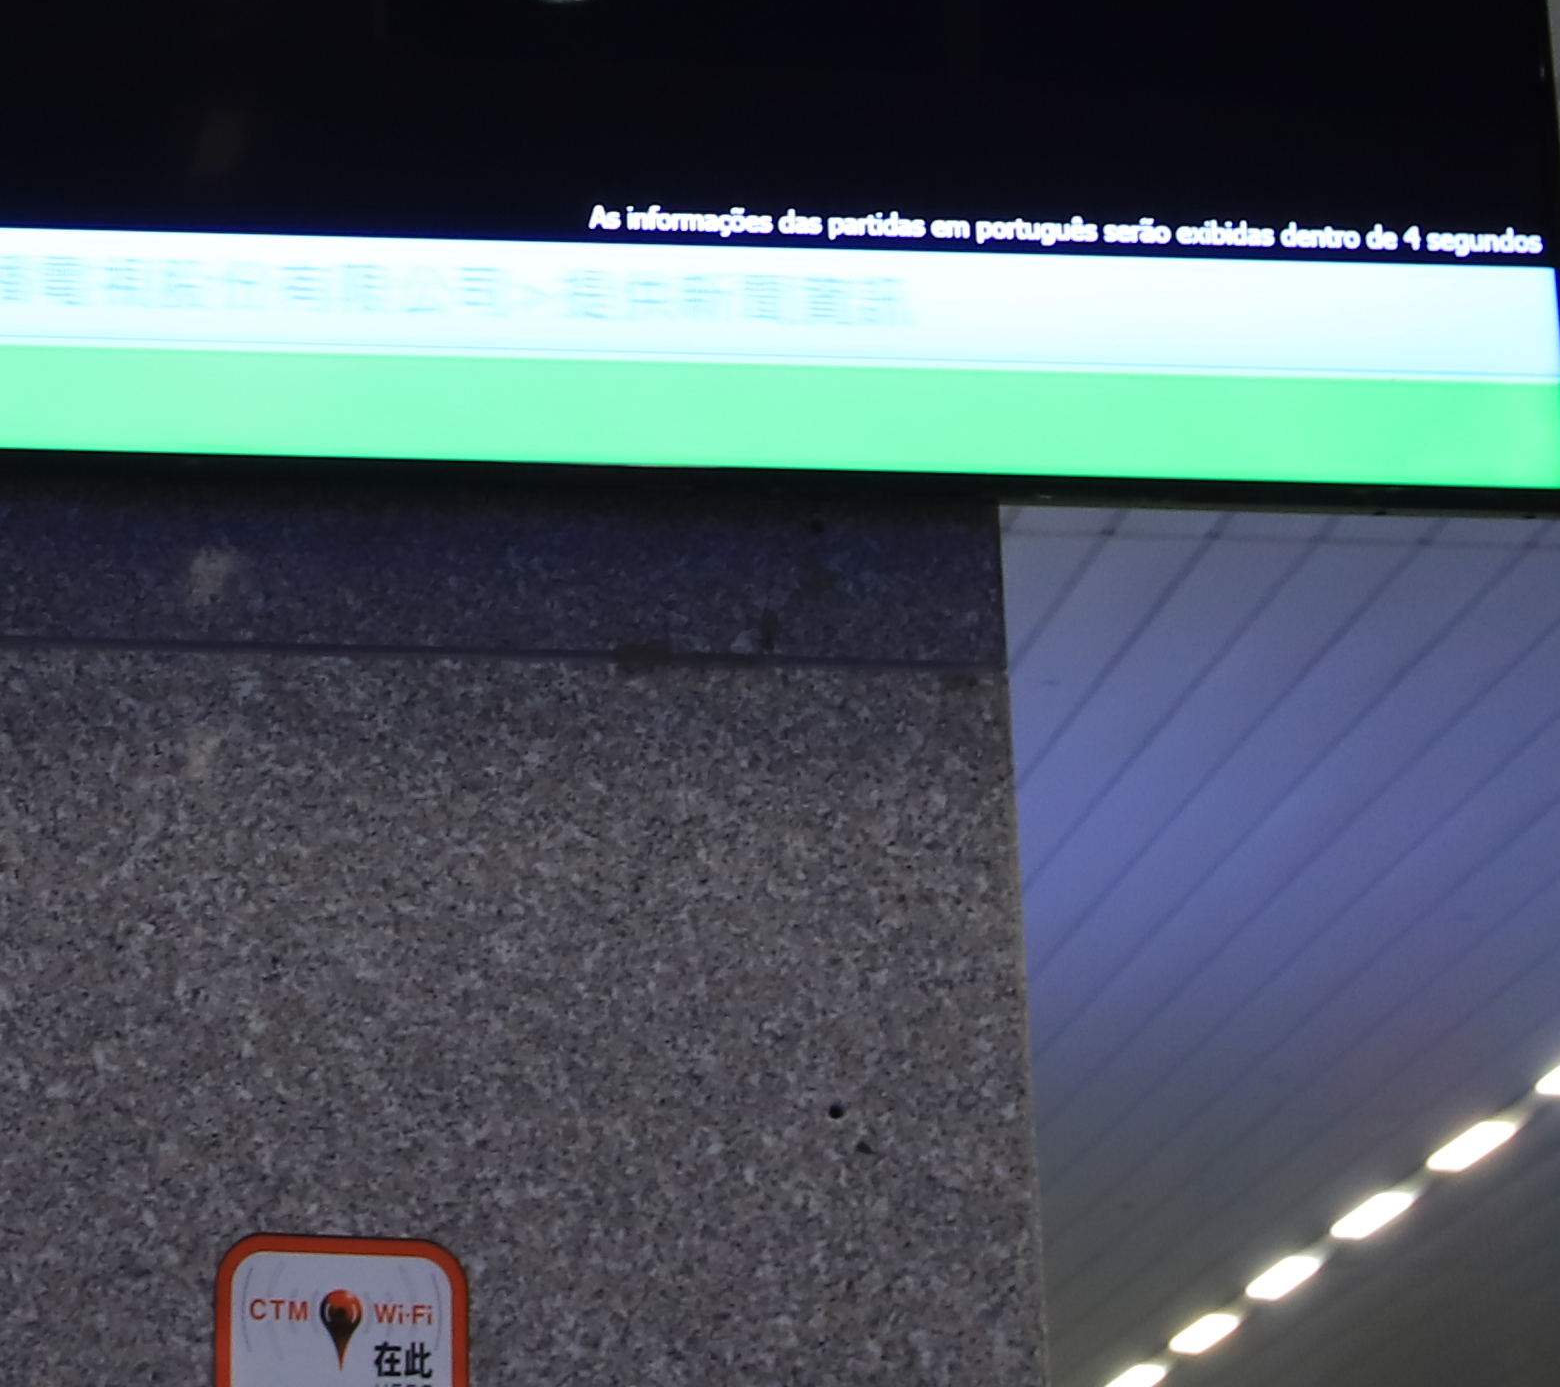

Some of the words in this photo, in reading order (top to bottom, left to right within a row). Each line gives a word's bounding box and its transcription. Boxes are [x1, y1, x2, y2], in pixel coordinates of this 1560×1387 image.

[589, 205, 621, 229] As
[627, 205, 773, 237] informações
[778, 209, 823, 235] das
[828, 211, 926, 240] partidas
[931, 220, 970, 238] em
[976, 216, 1098, 246] português
[1103, 218, 1171, 244] serão
[1176, 220, 1275, 246] exibidas
[1280, 222, 1361, 249] dentro
[1366, 224, 1398, 250] de
[1403, 226, 1421, 250] 4
[1427, 227, 1543, 257] segundos
[249, 1298, 310, 1321] CTM
[373, 1340, 433, 1379] 在此
